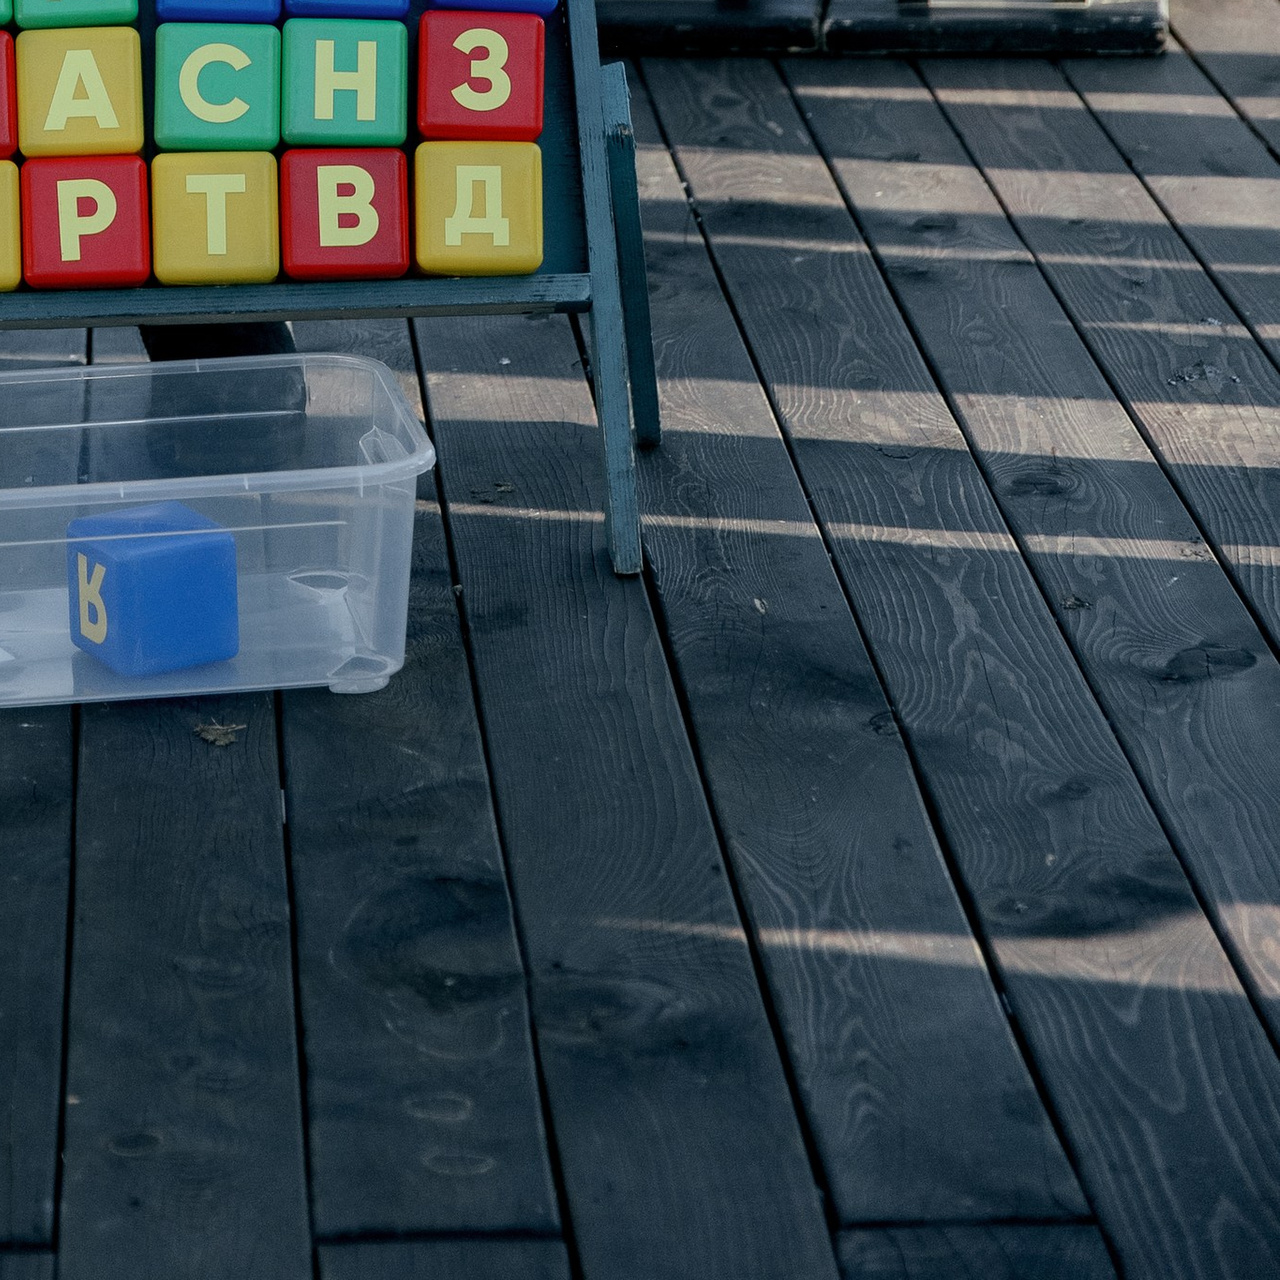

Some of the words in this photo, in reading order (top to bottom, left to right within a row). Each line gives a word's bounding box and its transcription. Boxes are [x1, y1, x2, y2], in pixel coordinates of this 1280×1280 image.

[44, 49, 119, 131] А
[179, 43, 250, 123] С
[315, 40, 377, 120] Н
[452, 28, 512, 111] З
[59, 178, 117, 261] Р
[185, 174, 246, 255] Т
[317, 165, 379, 247] В
[445, 166, 509, 246] Д
